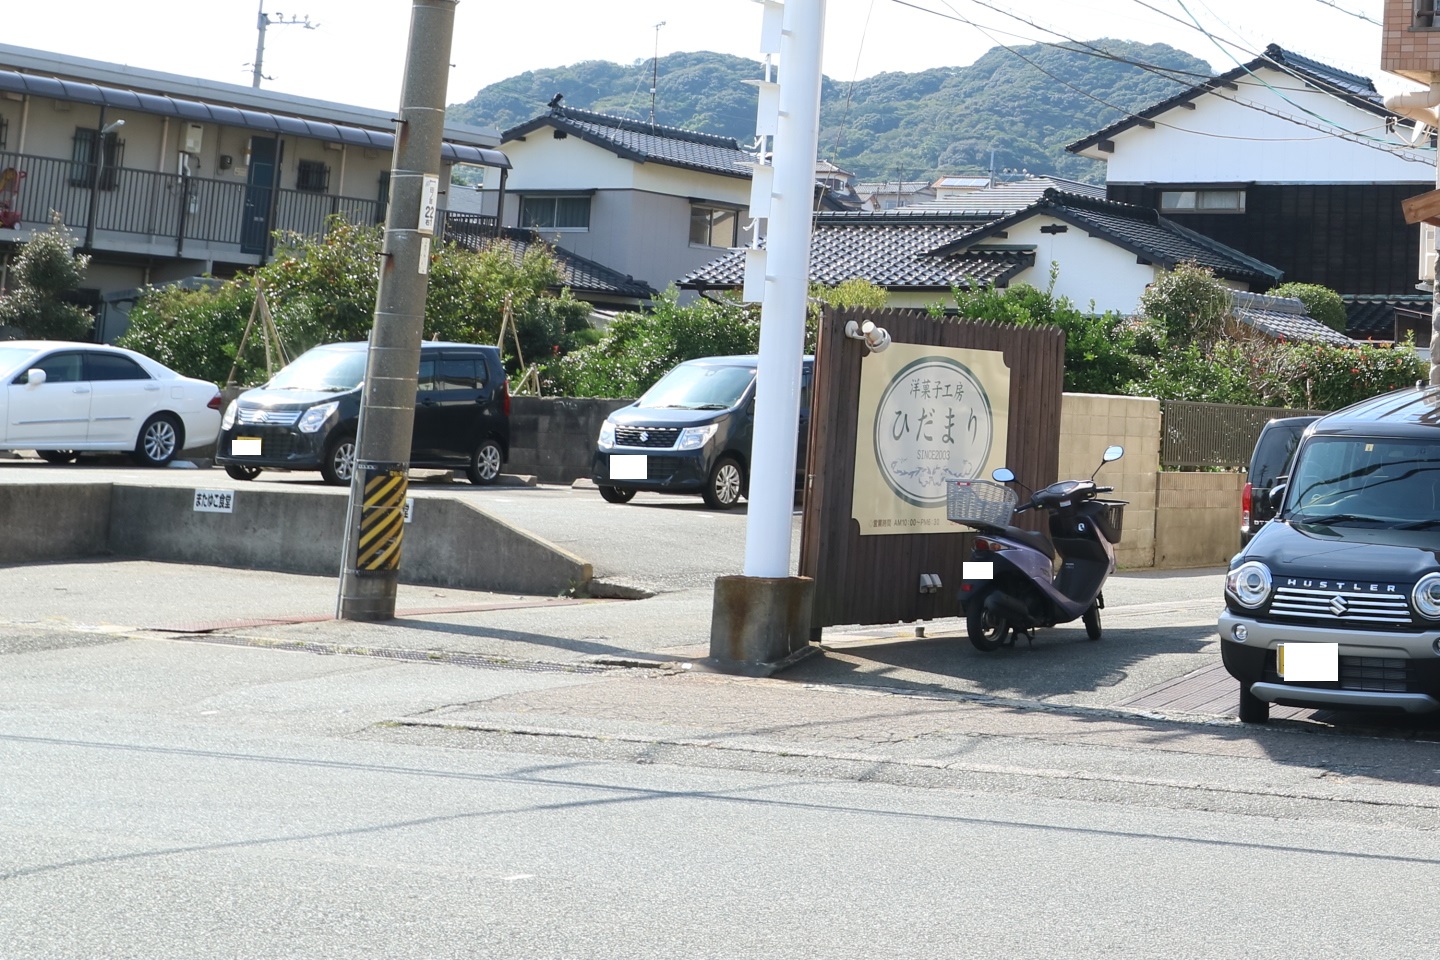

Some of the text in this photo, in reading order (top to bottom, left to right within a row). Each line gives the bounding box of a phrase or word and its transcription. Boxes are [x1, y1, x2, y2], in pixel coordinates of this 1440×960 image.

[909, 378, 965, 402] 洋菓子工房
[892, 407, 978, 445] ひだまり
[1287, 578, 1397, 592] HUSTLER
